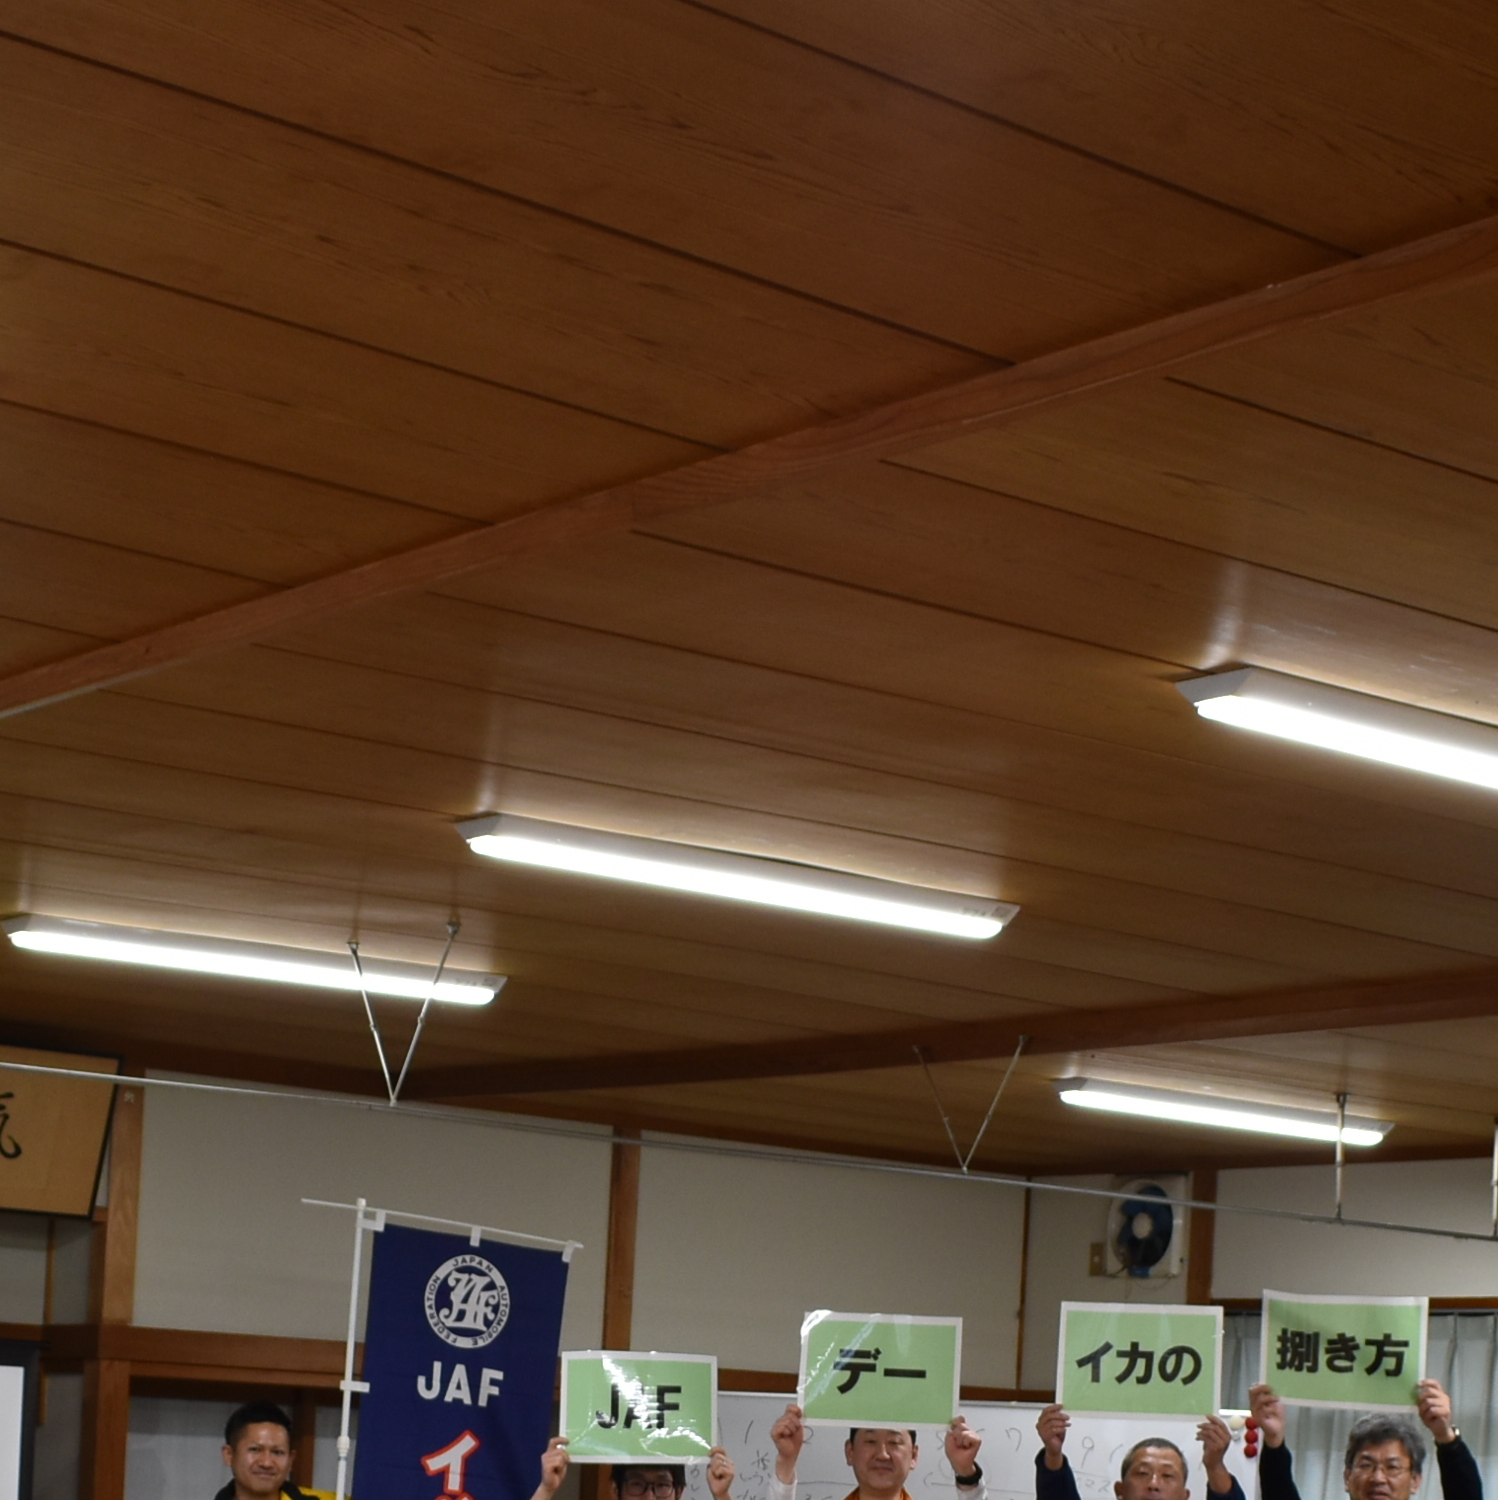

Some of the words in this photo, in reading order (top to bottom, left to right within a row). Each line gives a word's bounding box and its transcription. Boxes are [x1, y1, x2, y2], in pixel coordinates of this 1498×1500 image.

[452, 1256, 494, 1273] JAPAN
[426, 1275, 459, 1343] FEDERATION
[471, 1284, 509, 1346] AUTOMOBILE
[833, 1347, 927, 1395] デー
[1076, 1341, 1203, 1386] イカの
[1276, 1328, 1410, 1377] 捌き方
[417, 1361, 504, 1407] JAF
[595, 1385, 682, 1430] JAF
